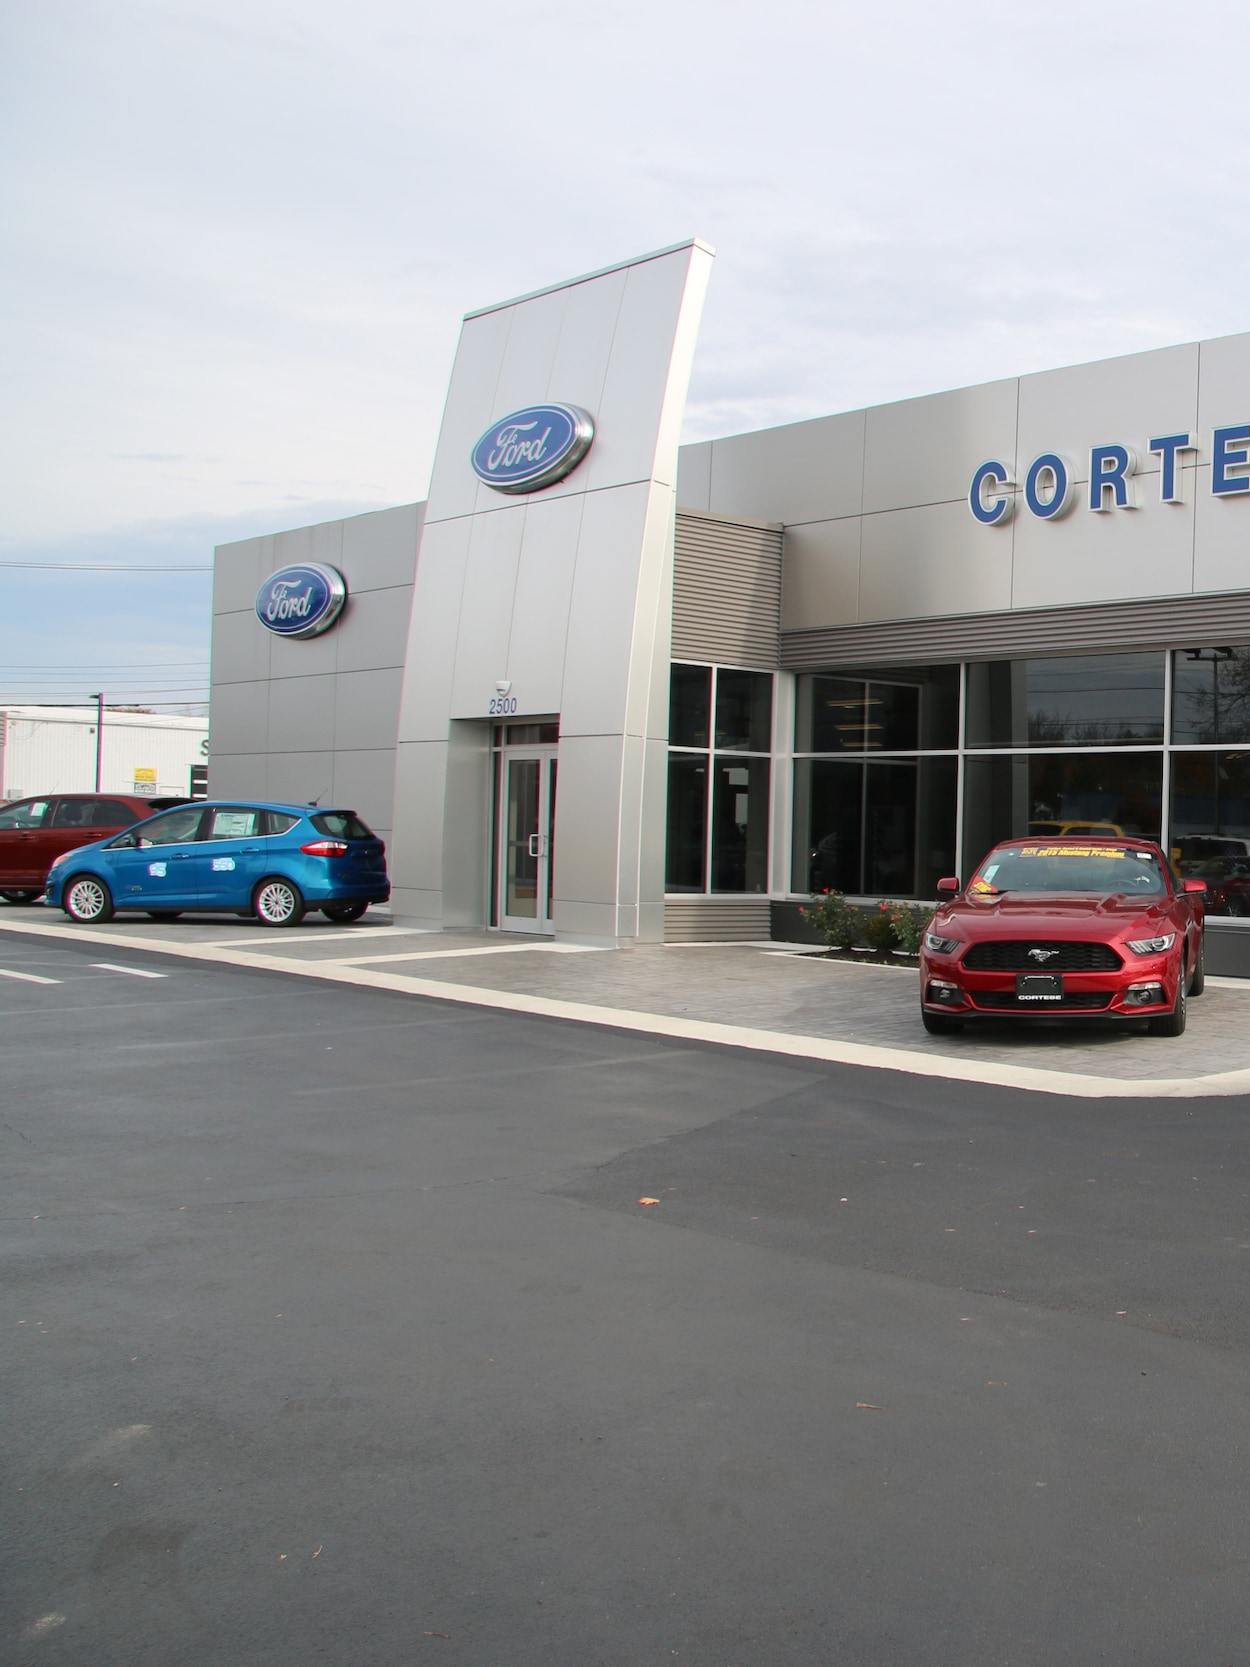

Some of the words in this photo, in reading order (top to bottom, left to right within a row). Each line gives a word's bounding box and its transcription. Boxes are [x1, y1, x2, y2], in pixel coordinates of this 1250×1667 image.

[488, 421, 552, 471] Ford
[267, 580, 313, 621] Ford
[489, 697, 517, 715] 2500
[1058, 849, 1090, 857] Mustang
[1091, 850, 1125, 859] Premium
